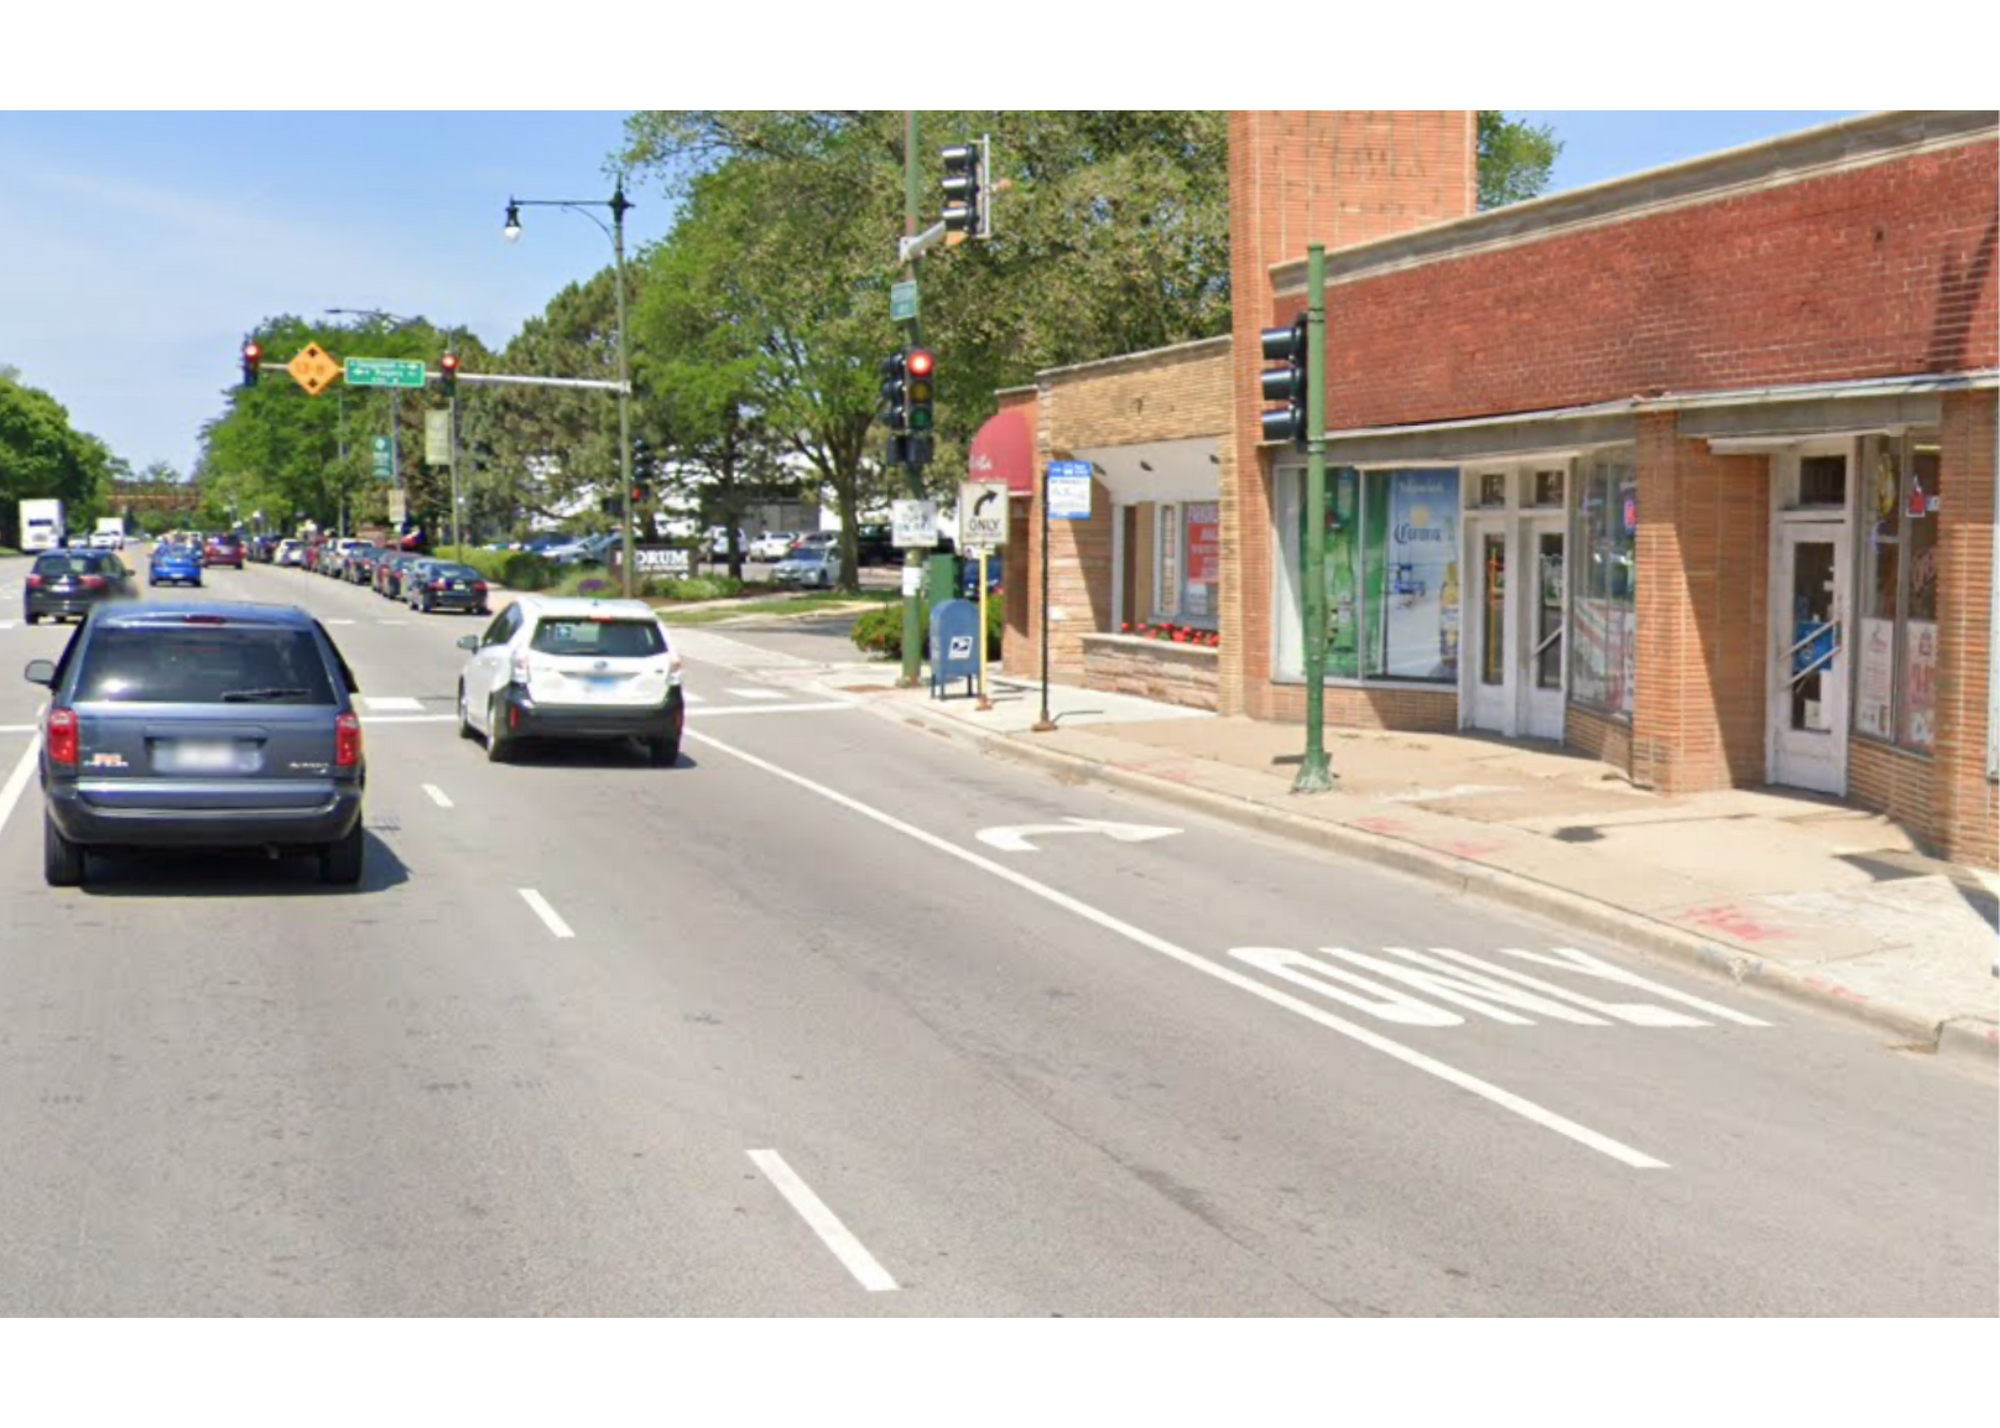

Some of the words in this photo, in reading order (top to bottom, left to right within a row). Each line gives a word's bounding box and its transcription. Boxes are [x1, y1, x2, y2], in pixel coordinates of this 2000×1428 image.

[969, 517, 1000, 532] ONLY
[1394, 522, 1441, 545] Corona
[1227, 946, 1773, 1026] ONLY
